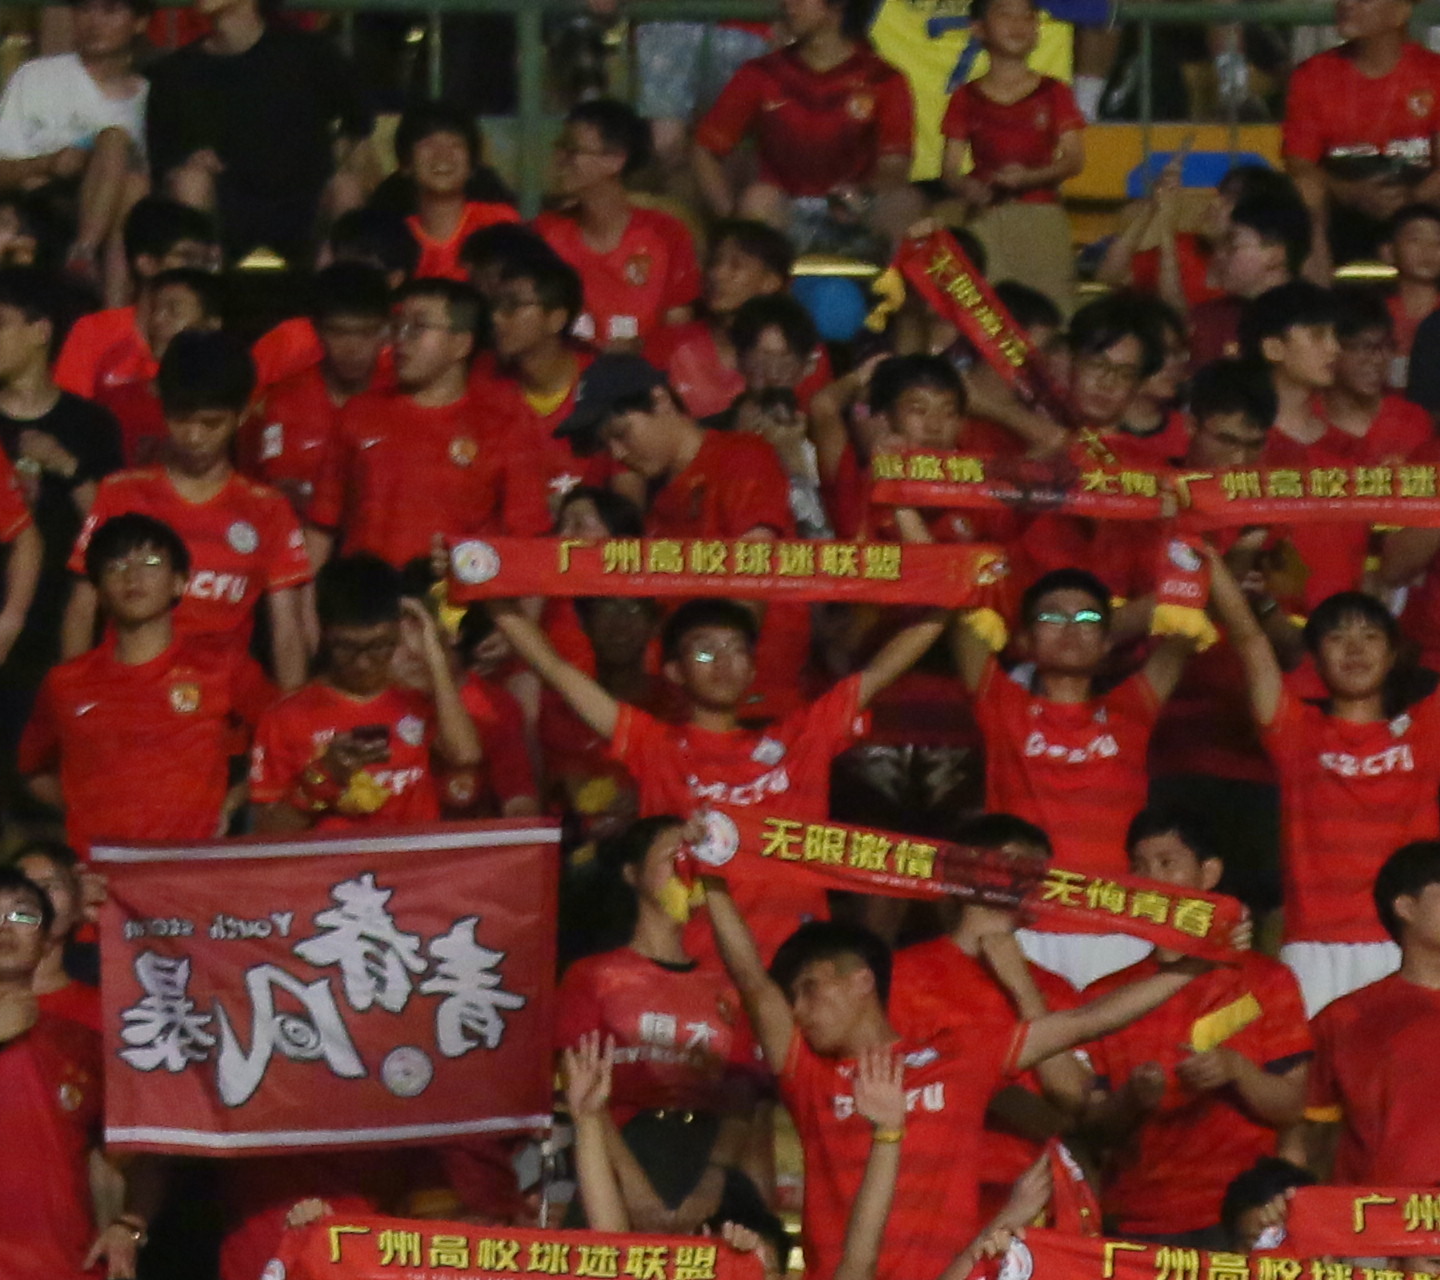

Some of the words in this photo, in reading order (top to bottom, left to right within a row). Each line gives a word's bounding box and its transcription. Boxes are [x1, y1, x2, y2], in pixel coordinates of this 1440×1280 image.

[559, 539, 901, 580] 广州高校球迷联盟
[762, 817, 937, 881] 无限激情
[1042, 869, 1217, 940] 无悔青春
